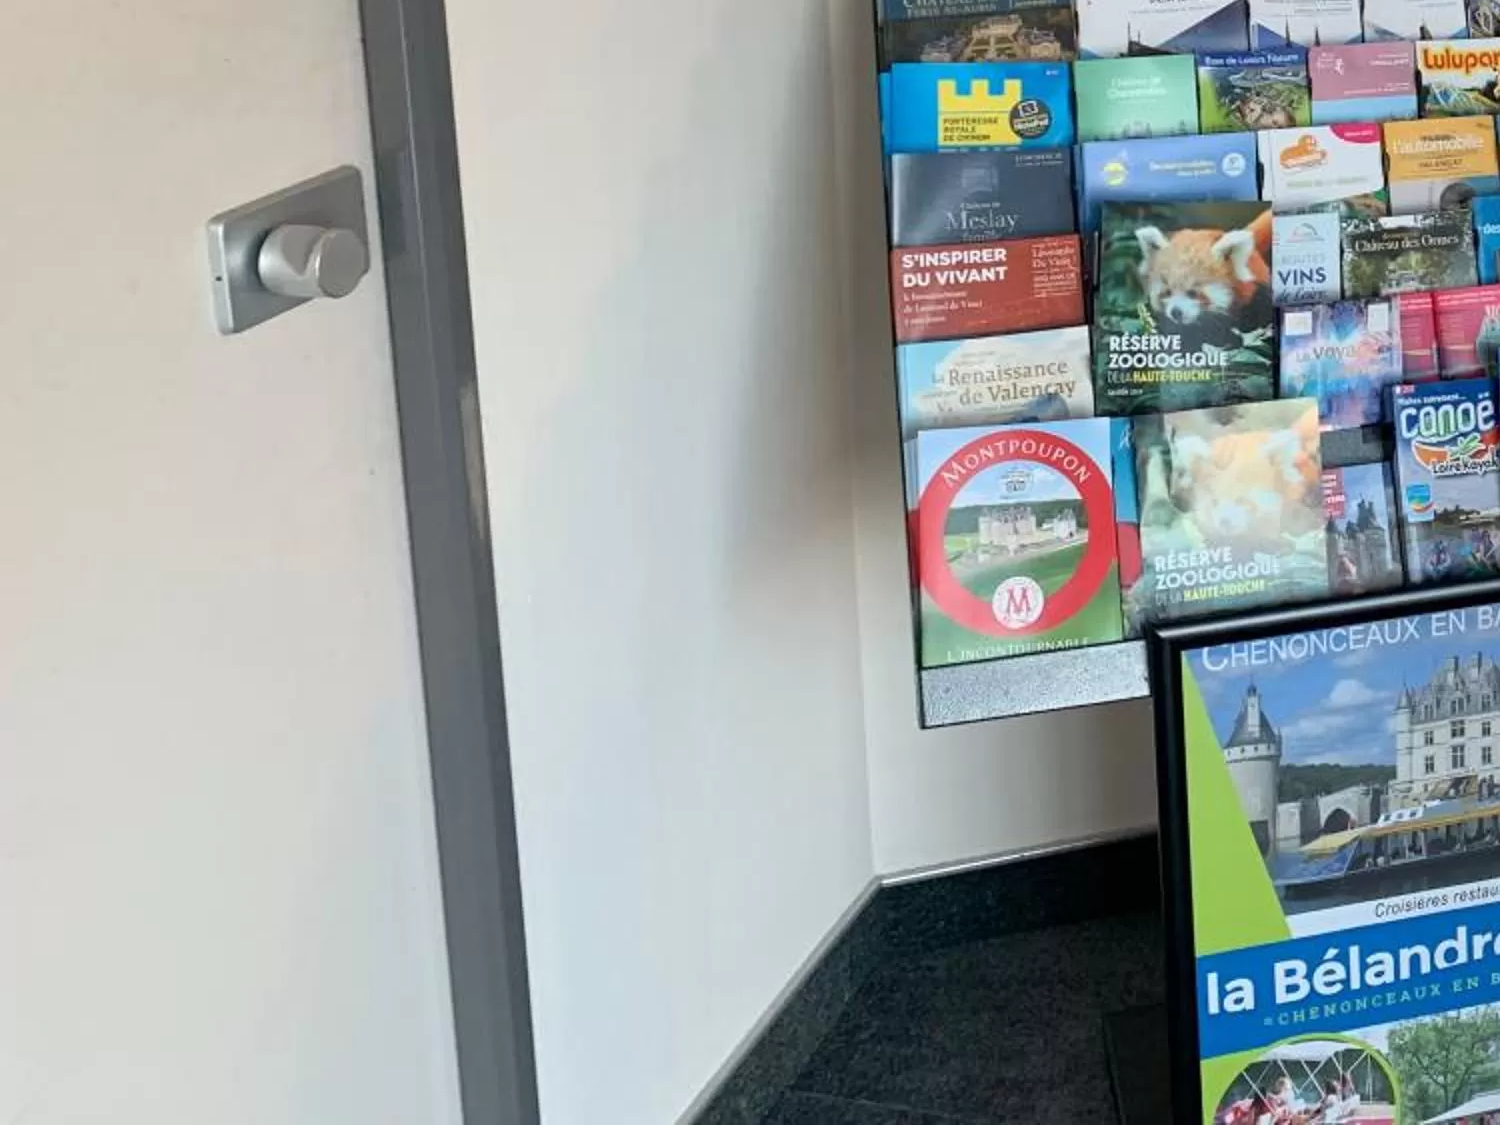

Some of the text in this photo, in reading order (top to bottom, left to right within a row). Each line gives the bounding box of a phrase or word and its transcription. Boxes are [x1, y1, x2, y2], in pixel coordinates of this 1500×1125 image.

[902, 248, 1008, 269] S'INSPIRER
[903, 266, 1008, 288] DU VIVANT
[1278, 267, 1327, 286] VINS
[1109, 332, 1181, 351] RÉSERVE
[1108, 351, 1230, 368] ZOOLOGIQUE
[948, 359, 1068, 386] Renaissance
[959, 390, 984, 407] de
[941, 438, 1091, 489] MONTPOUPON
[1155, 546, 1232, 572] RÉSERVE
[1155, 553, 1280, 591] ZOOLOGIQUE
[1006, 586, 1031, 615] M
[1202, 621, 1421, 671] CHENONCEAUX
[1431, 610, 1466, 636] EN
[1375, 893, 1449, 918] Croisières
[1207, 971, 1255, 1015] la
[1453, 976, 1480, 993] EN
